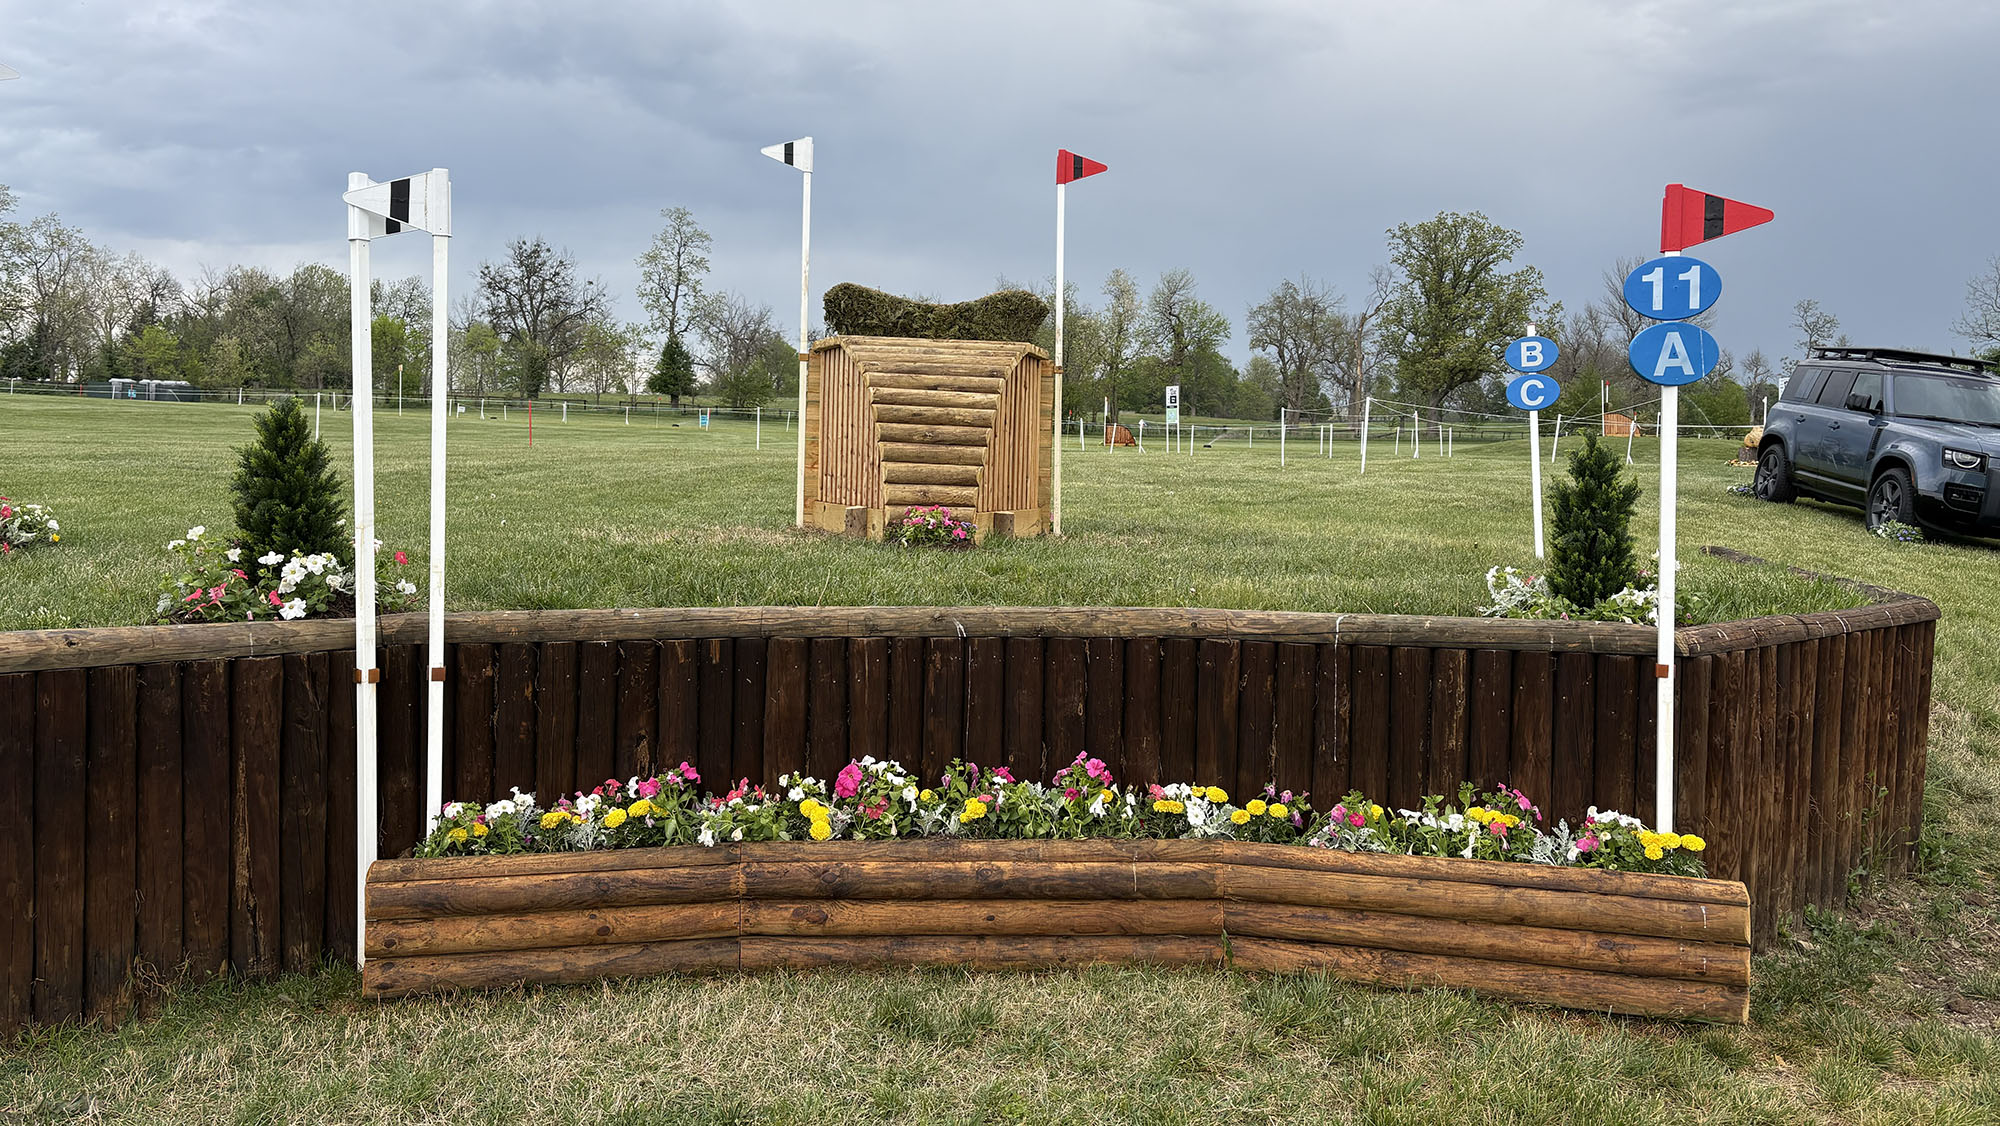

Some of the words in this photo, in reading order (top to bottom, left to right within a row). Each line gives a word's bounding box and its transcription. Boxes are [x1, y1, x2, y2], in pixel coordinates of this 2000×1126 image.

[1641, 265, 1701, 311] 11
[1520, 341, 1544, 368] B
[1653, 331, 1695, 377] A
[1520, 379, 1545, 406] C
